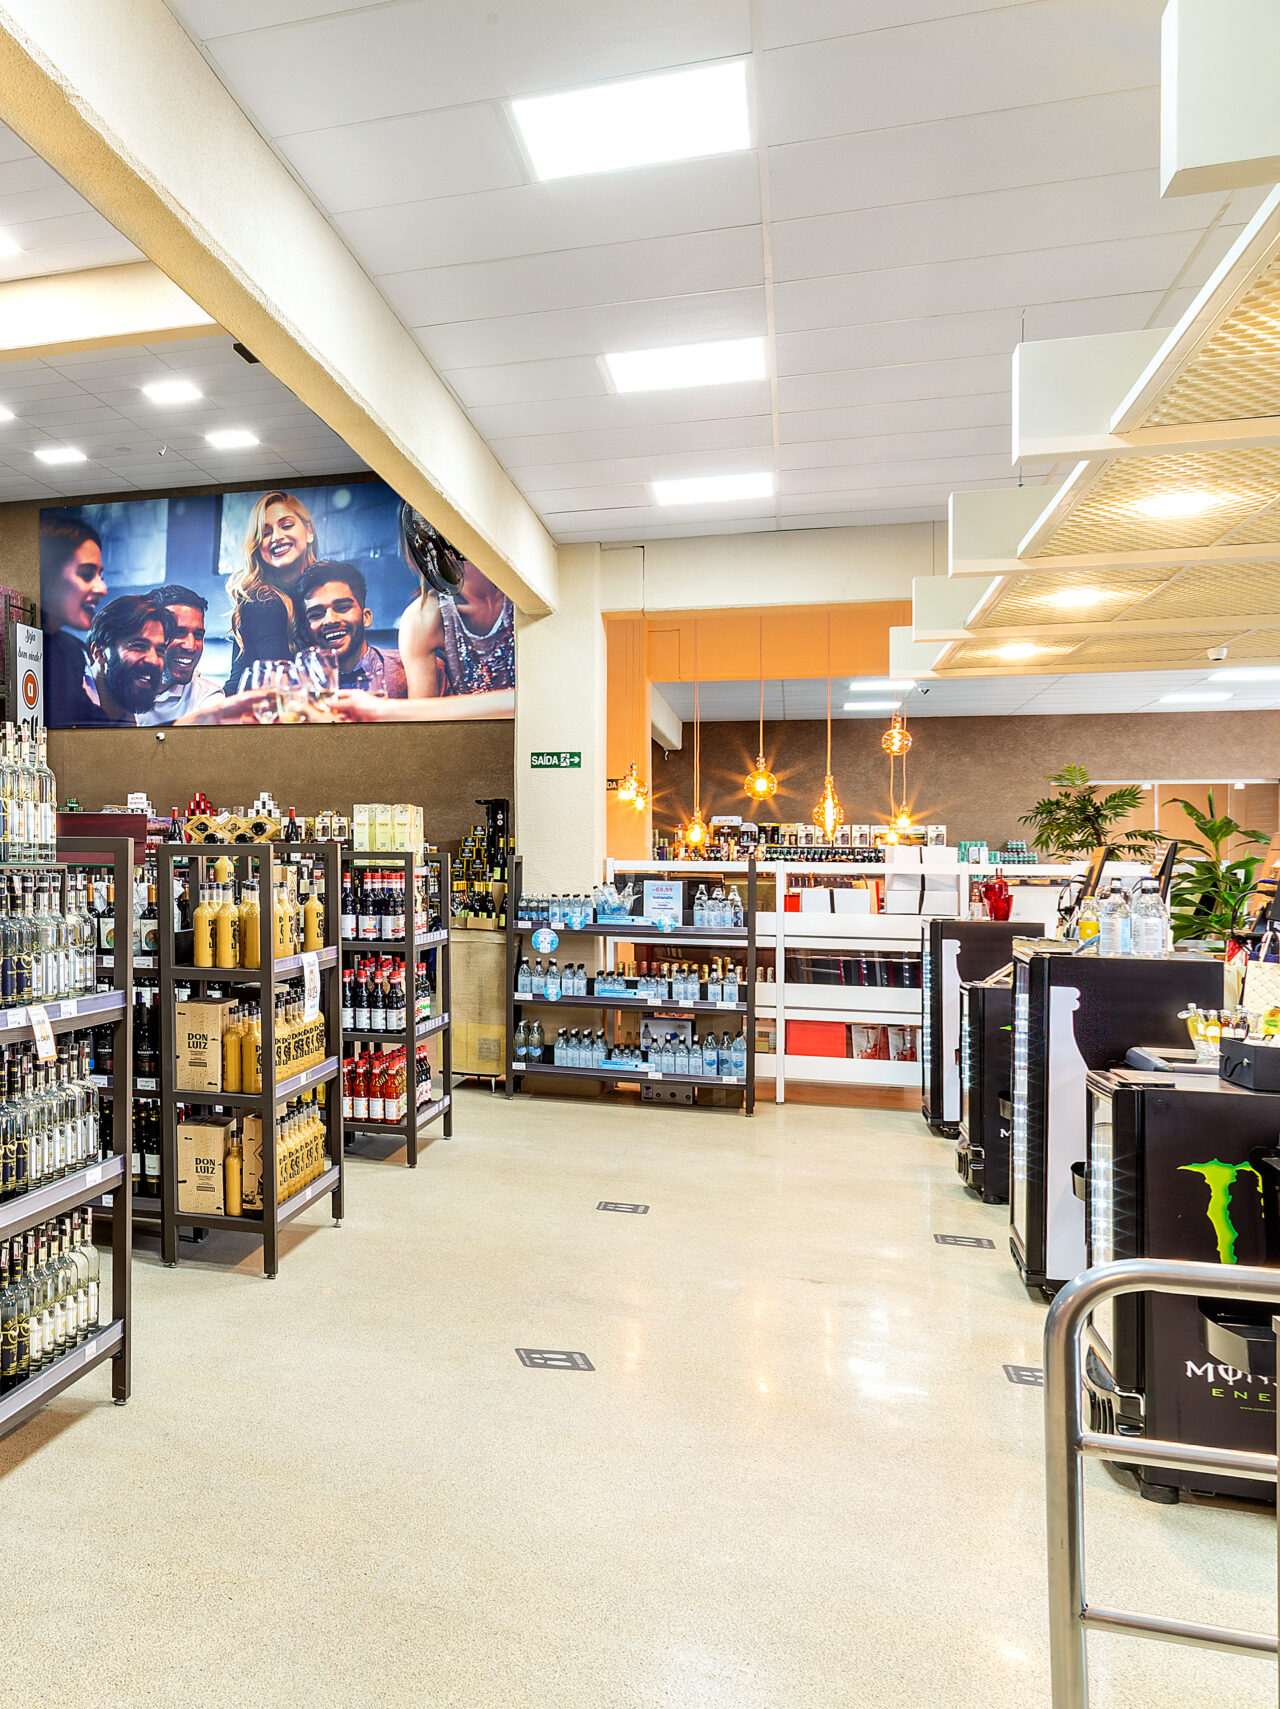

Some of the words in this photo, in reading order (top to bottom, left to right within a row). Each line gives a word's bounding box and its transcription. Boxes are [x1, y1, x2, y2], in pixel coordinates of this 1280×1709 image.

[531, 753, 559, 765] SAÍDA
[187, 1032, 208, 1041] DON
[187, 1041, 208, 1050] LUIZ
[195, 1157, 216, 1166] DON
[195, 1166, 216, 1175] LUIZ
[1211, 1388, 1272, 1402] ENE
